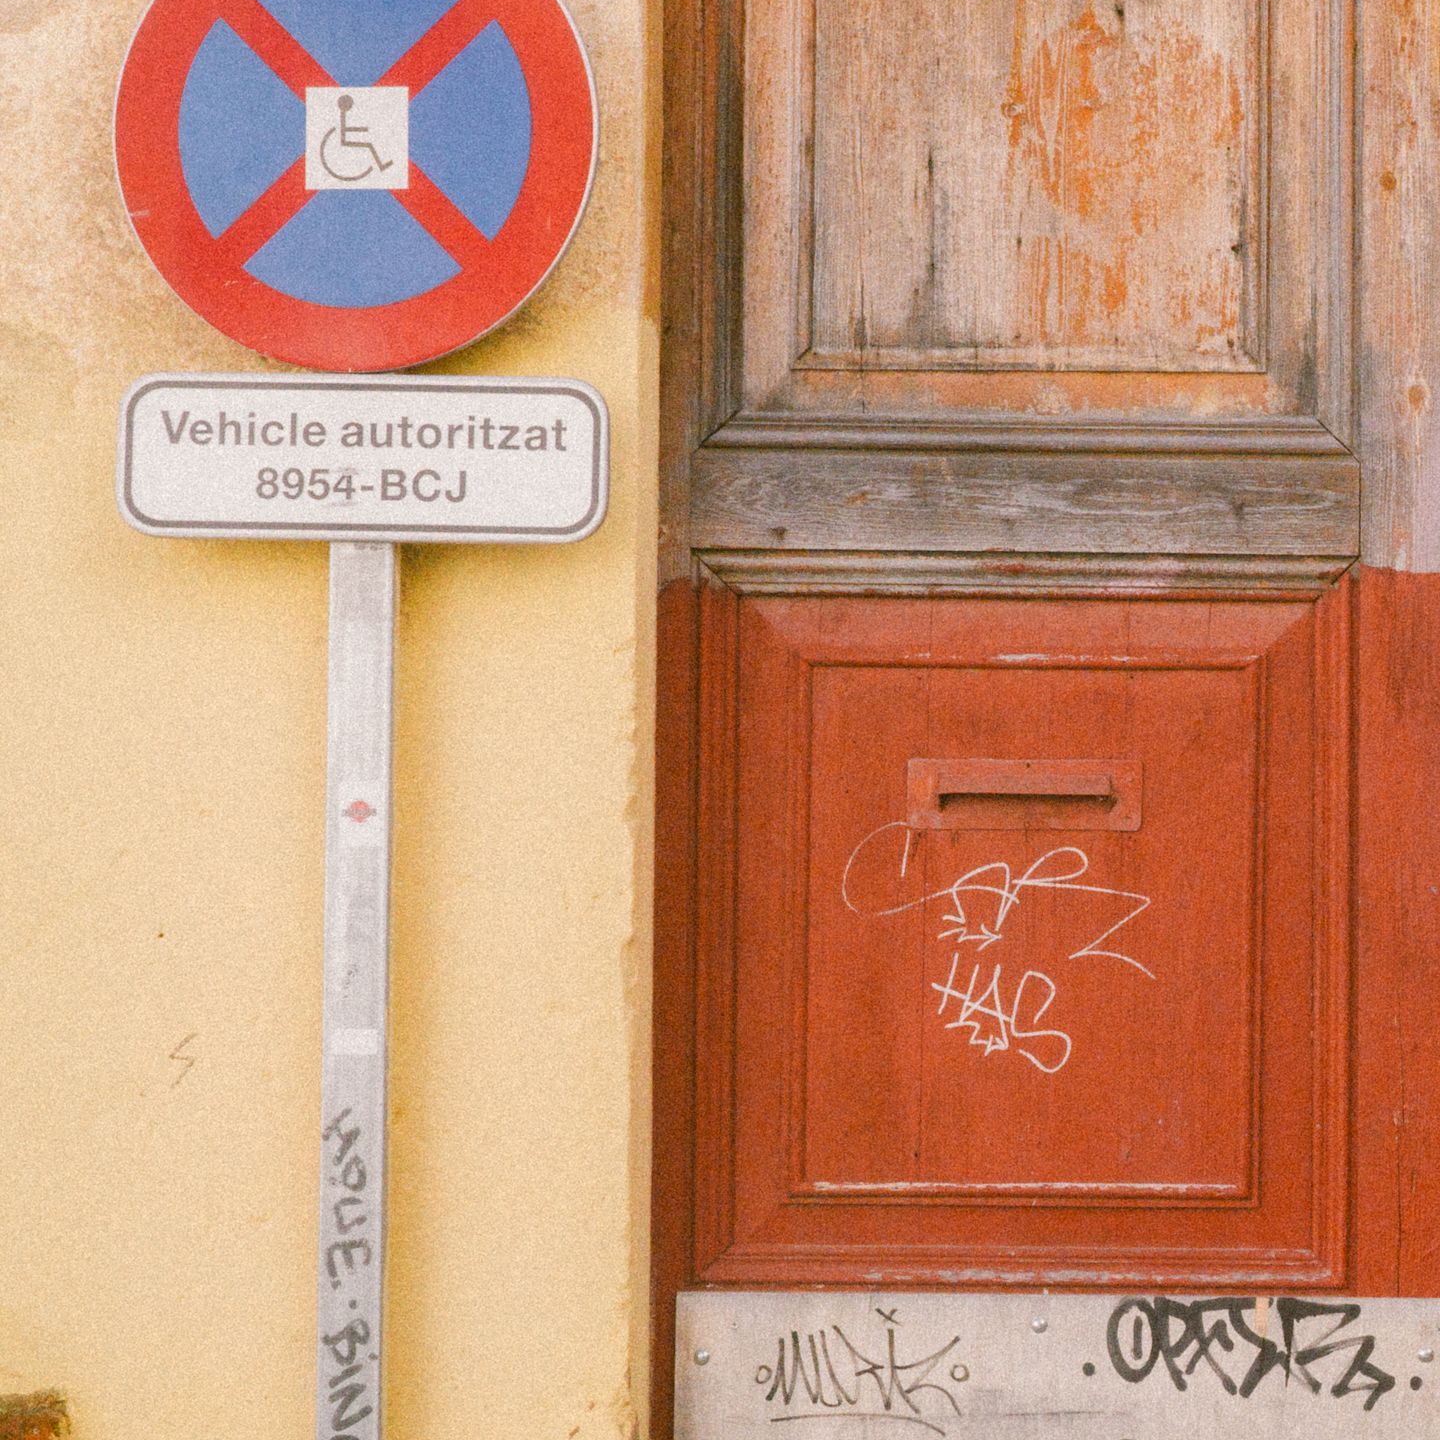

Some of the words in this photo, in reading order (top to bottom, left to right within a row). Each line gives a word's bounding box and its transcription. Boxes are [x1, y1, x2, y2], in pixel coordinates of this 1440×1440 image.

[160, 409, 329, 449] Vehicle
[339, 413, 569, 453] autoritzat
[255, 466, 469, 504] 8954-BCJ
